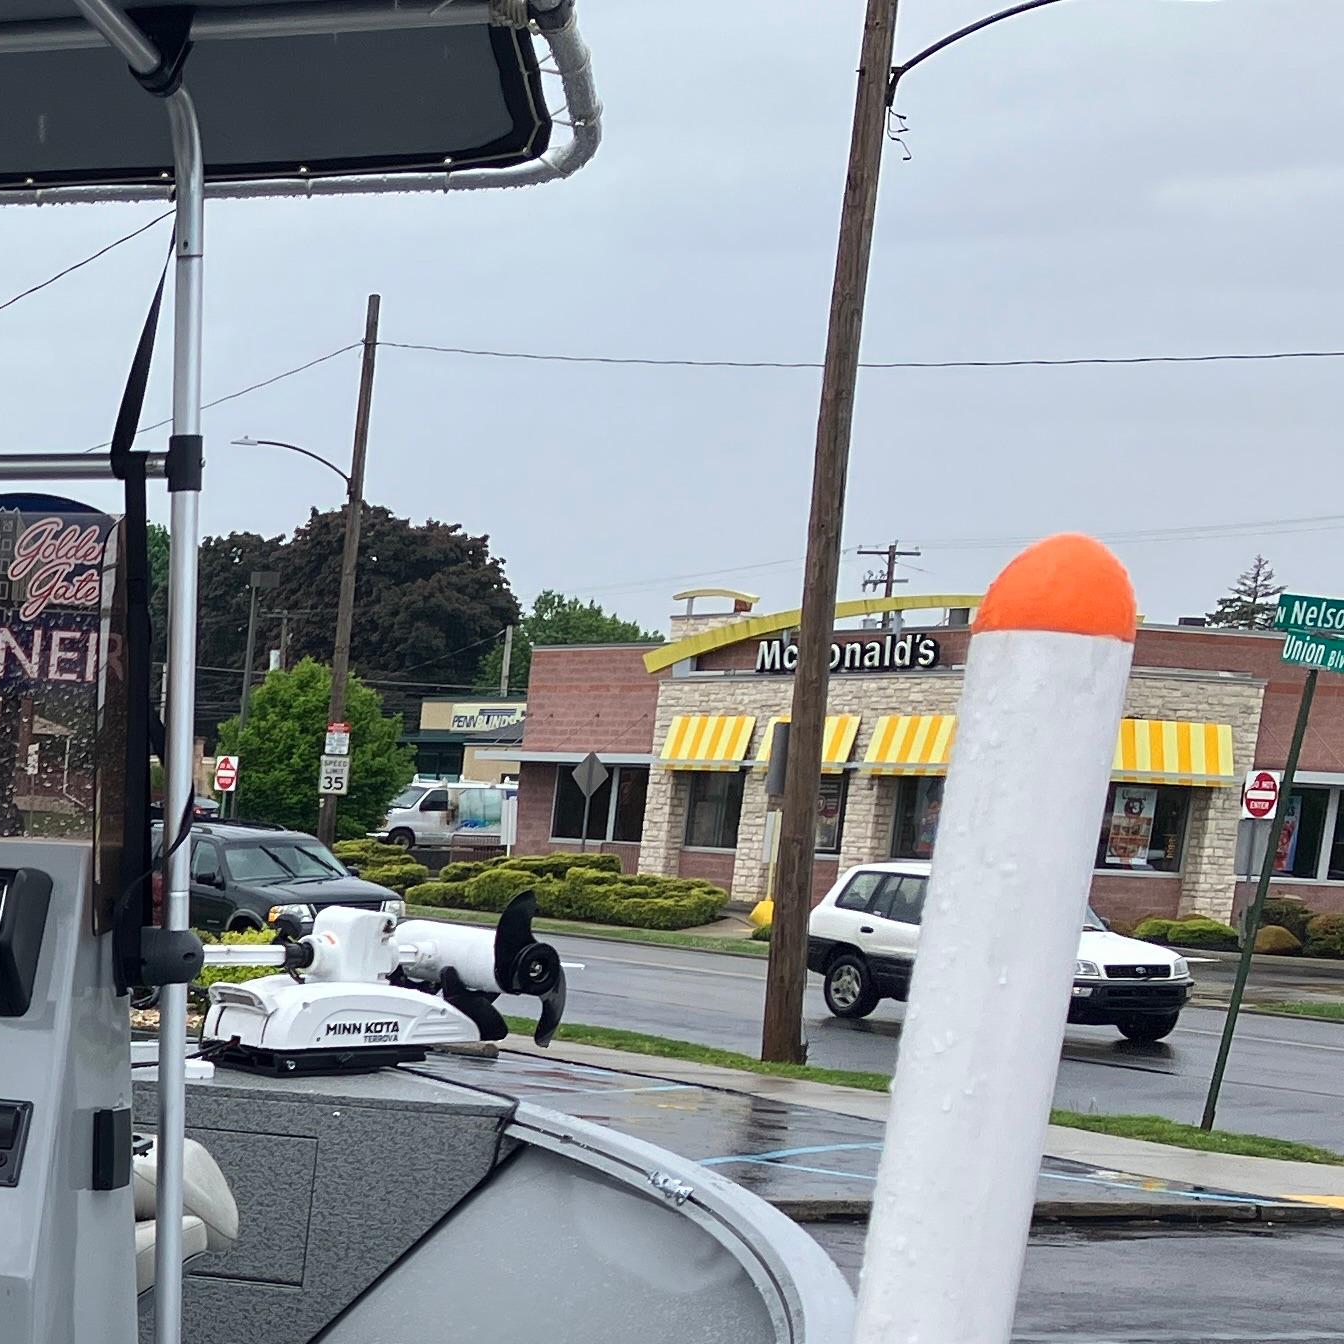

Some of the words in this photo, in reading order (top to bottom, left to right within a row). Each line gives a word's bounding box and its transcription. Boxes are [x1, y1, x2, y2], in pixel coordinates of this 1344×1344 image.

[7, 517, 105, 581] Golde
[19, 561, 101, 621] Gate
[1274, 606, 1287, 624] N
[1290, 600, 1344, 629] Nelso
[755, 634, 936, 671] Mconald's
[1282, 634, 1326, 665] Union
[322, 776, 344, 791] 35
[325, 1022, 362, 1036] MINN
[365, 1020, 400, 1034] KOTA
